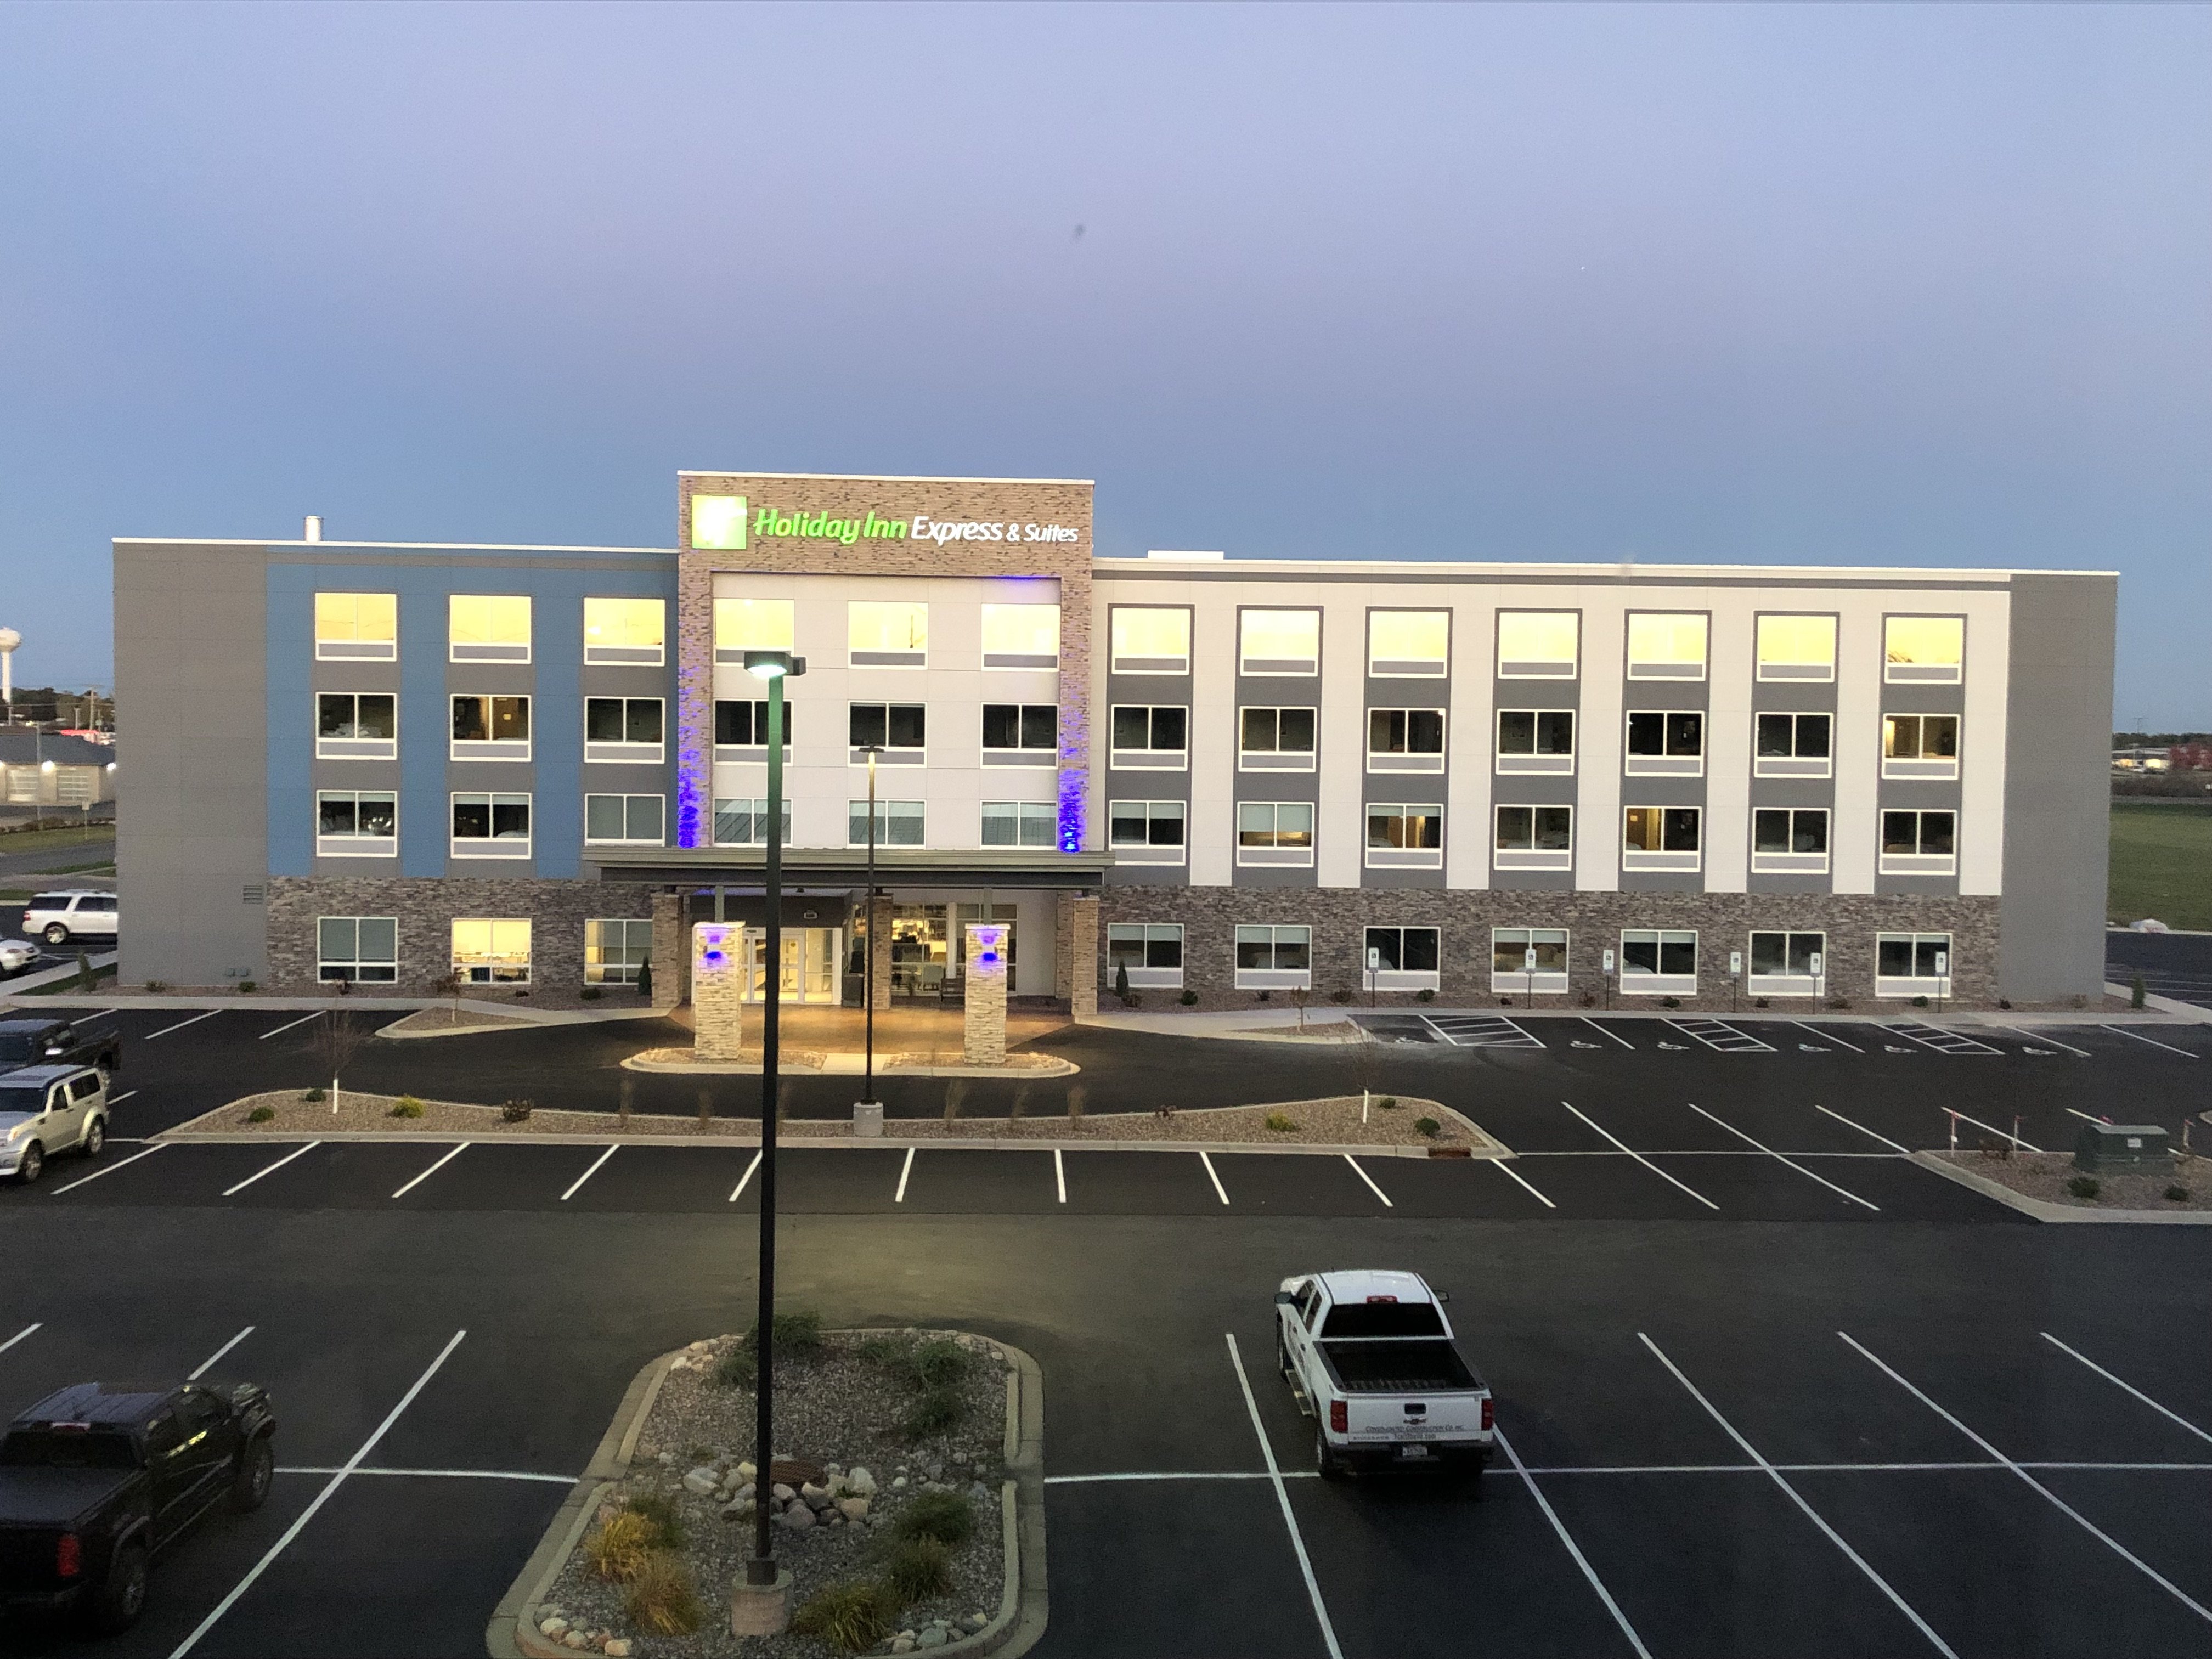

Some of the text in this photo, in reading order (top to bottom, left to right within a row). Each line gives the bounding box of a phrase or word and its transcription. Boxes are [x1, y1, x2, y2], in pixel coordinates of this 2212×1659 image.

[753, 509, 1079, 546] Holiday Inn Express & Suites
